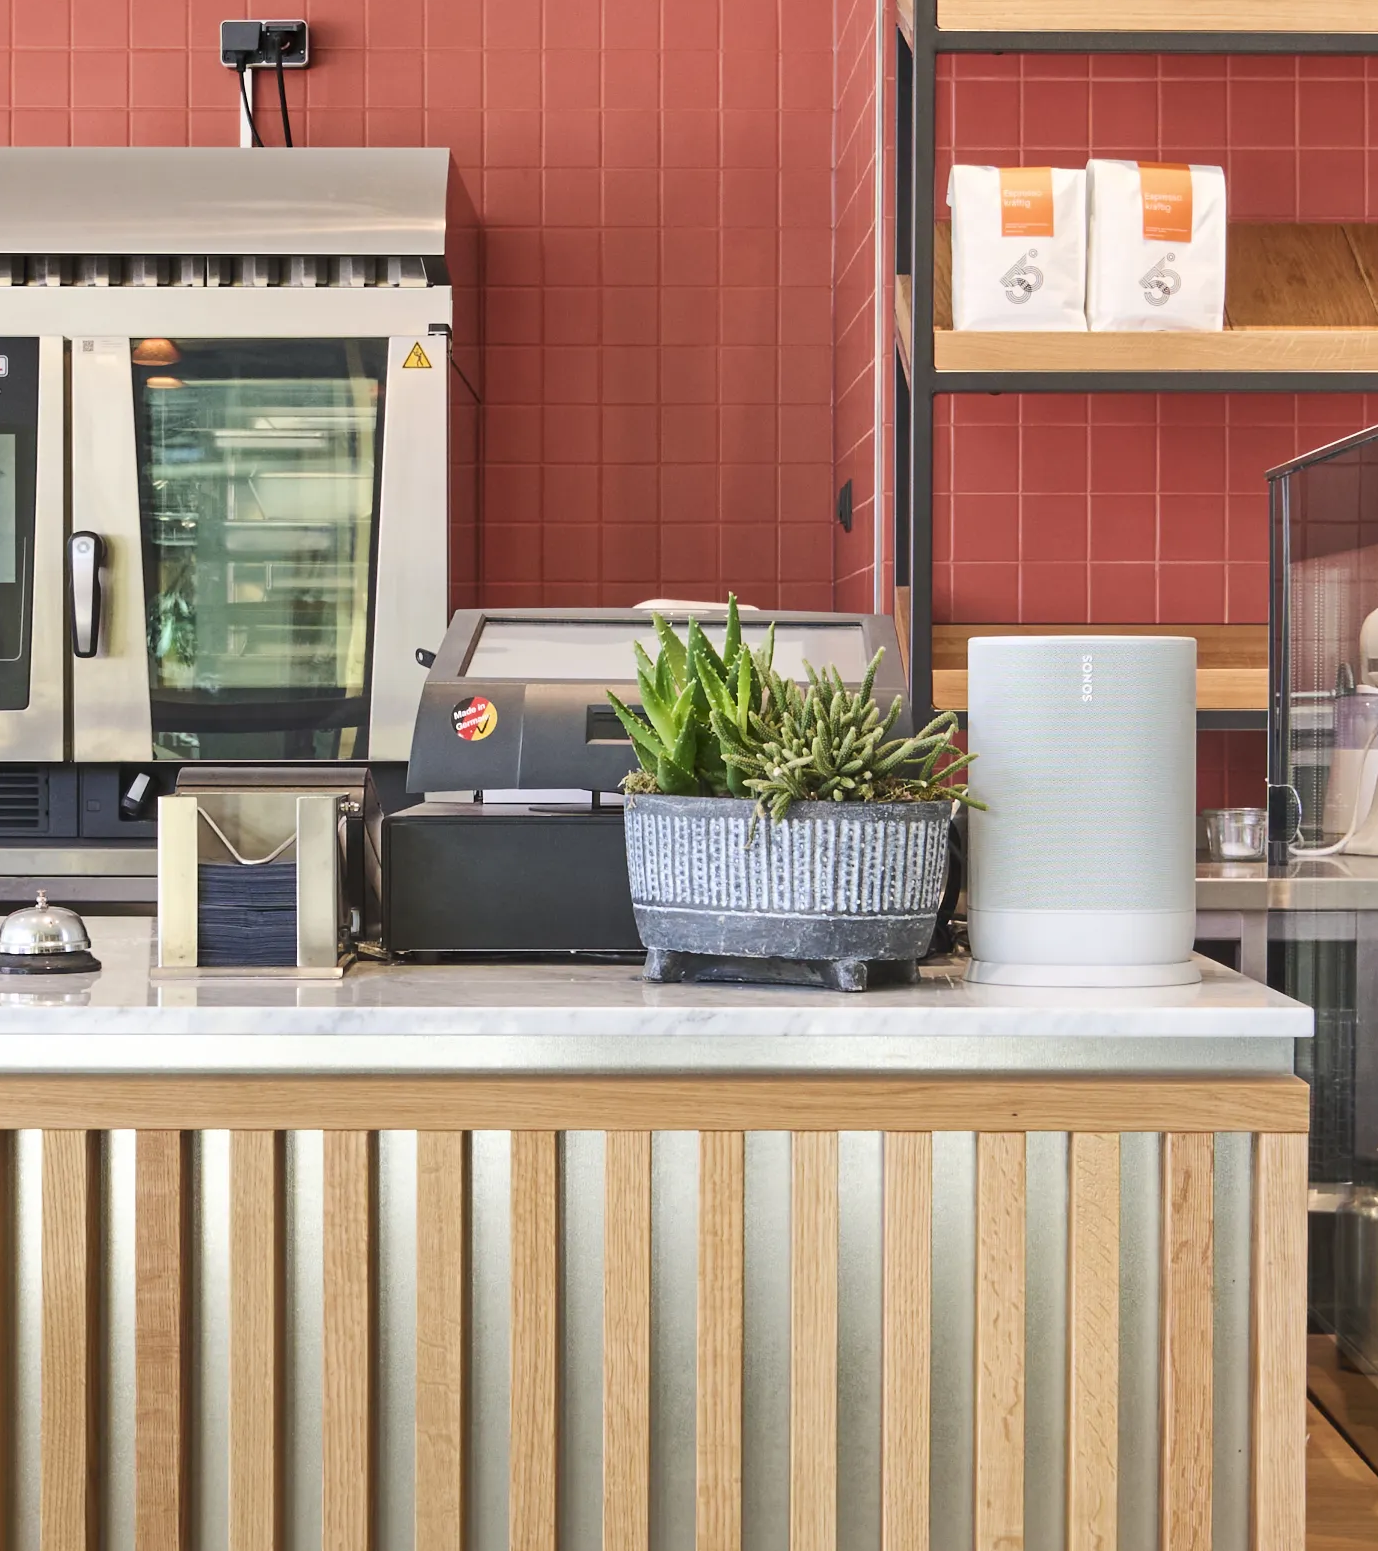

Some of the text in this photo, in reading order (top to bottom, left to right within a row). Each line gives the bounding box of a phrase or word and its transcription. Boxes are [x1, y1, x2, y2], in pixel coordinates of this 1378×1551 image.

[1081, 654, 1093, 702] SONOS
[454, 707, 476, 720] Made
[456, 714, 490, 730] Germany
